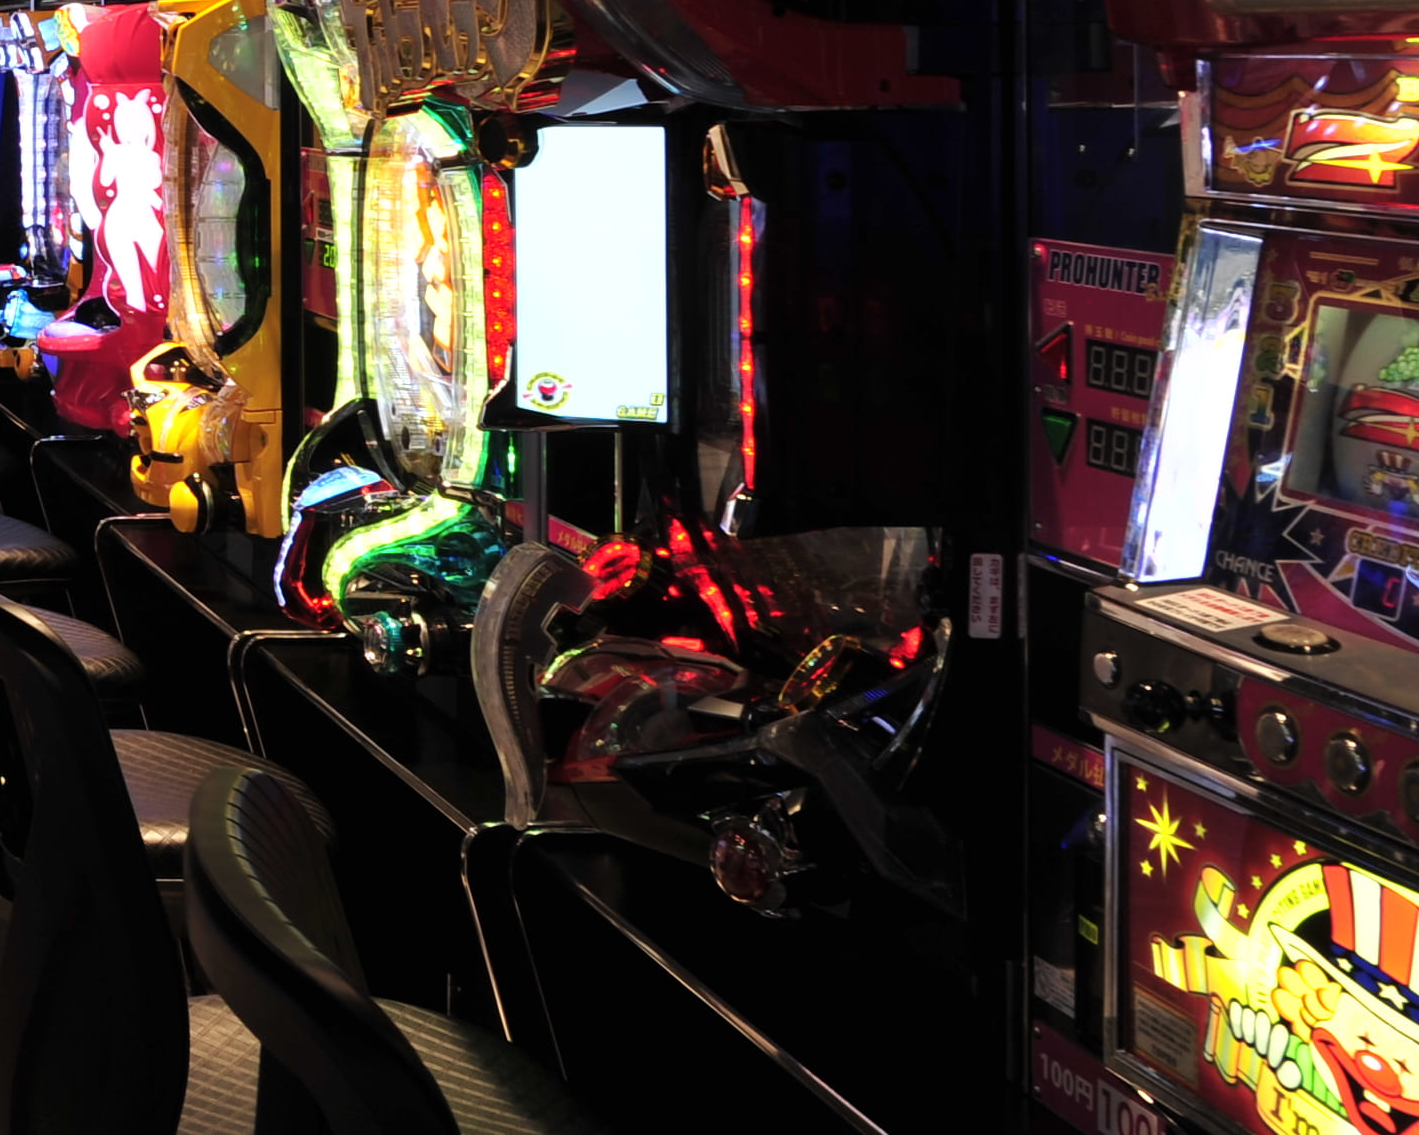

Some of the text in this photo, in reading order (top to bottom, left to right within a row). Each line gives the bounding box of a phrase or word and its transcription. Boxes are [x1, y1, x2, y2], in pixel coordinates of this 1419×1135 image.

[1048, 249, 1161, 297] PROHUNTER
[1215, 549, 1276, 583] CHANCE
[1039, 1052, 1094, 1112] 100円
